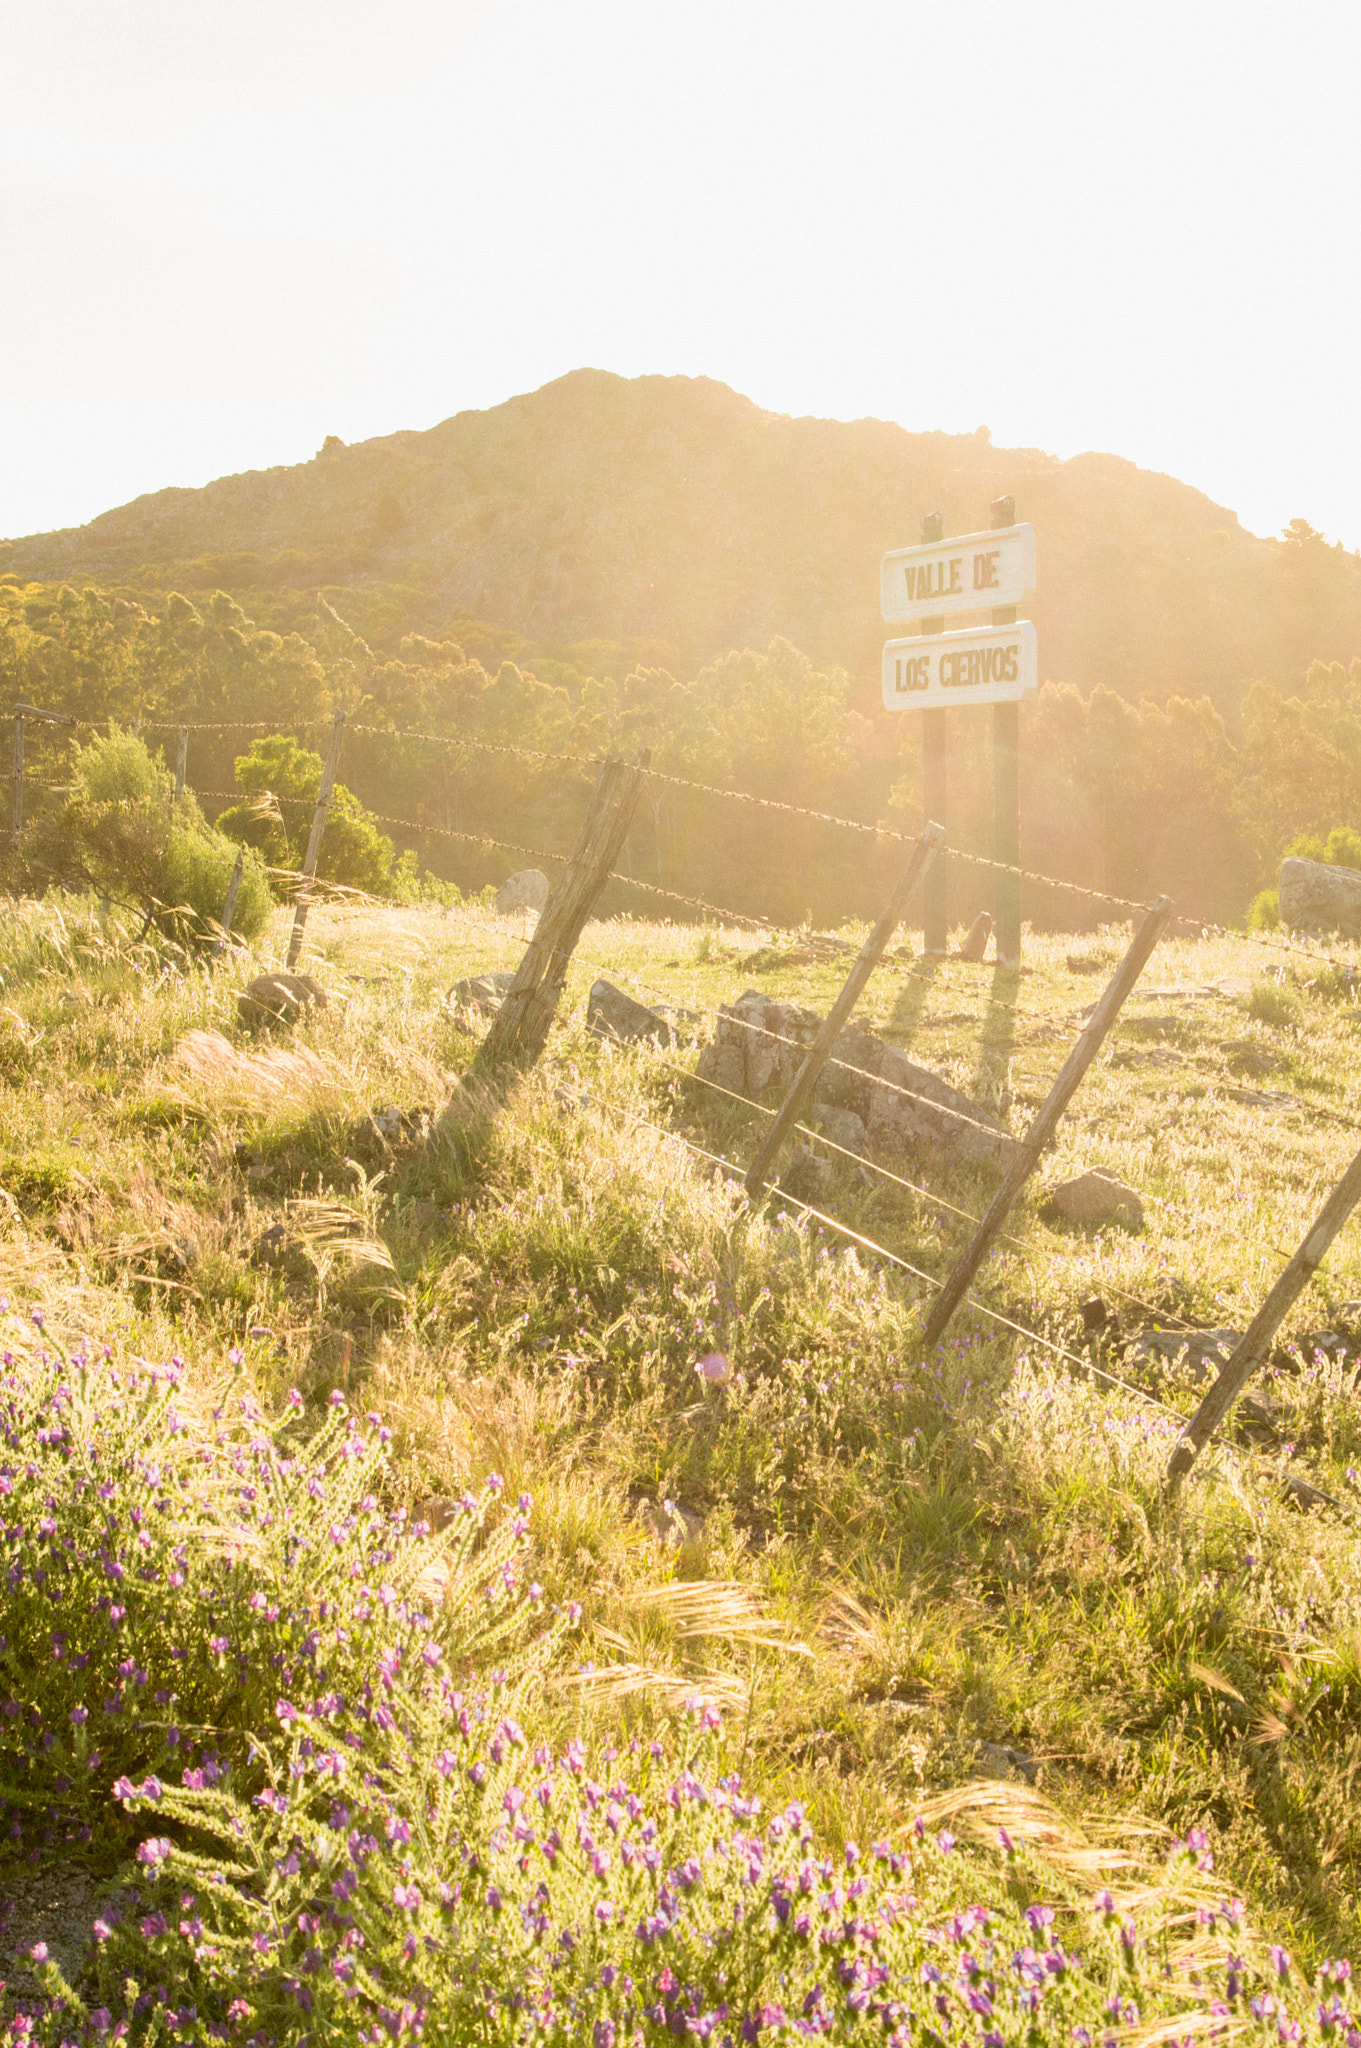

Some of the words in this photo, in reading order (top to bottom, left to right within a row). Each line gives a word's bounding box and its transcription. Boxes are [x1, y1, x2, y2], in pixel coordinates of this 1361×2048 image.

[904, 558, 963, 601] VALLE
[973, 550, 1000, 591] DE
[895, 655, 930, 693] LOS
[938, 644, 1019, 688] CIERVOS
